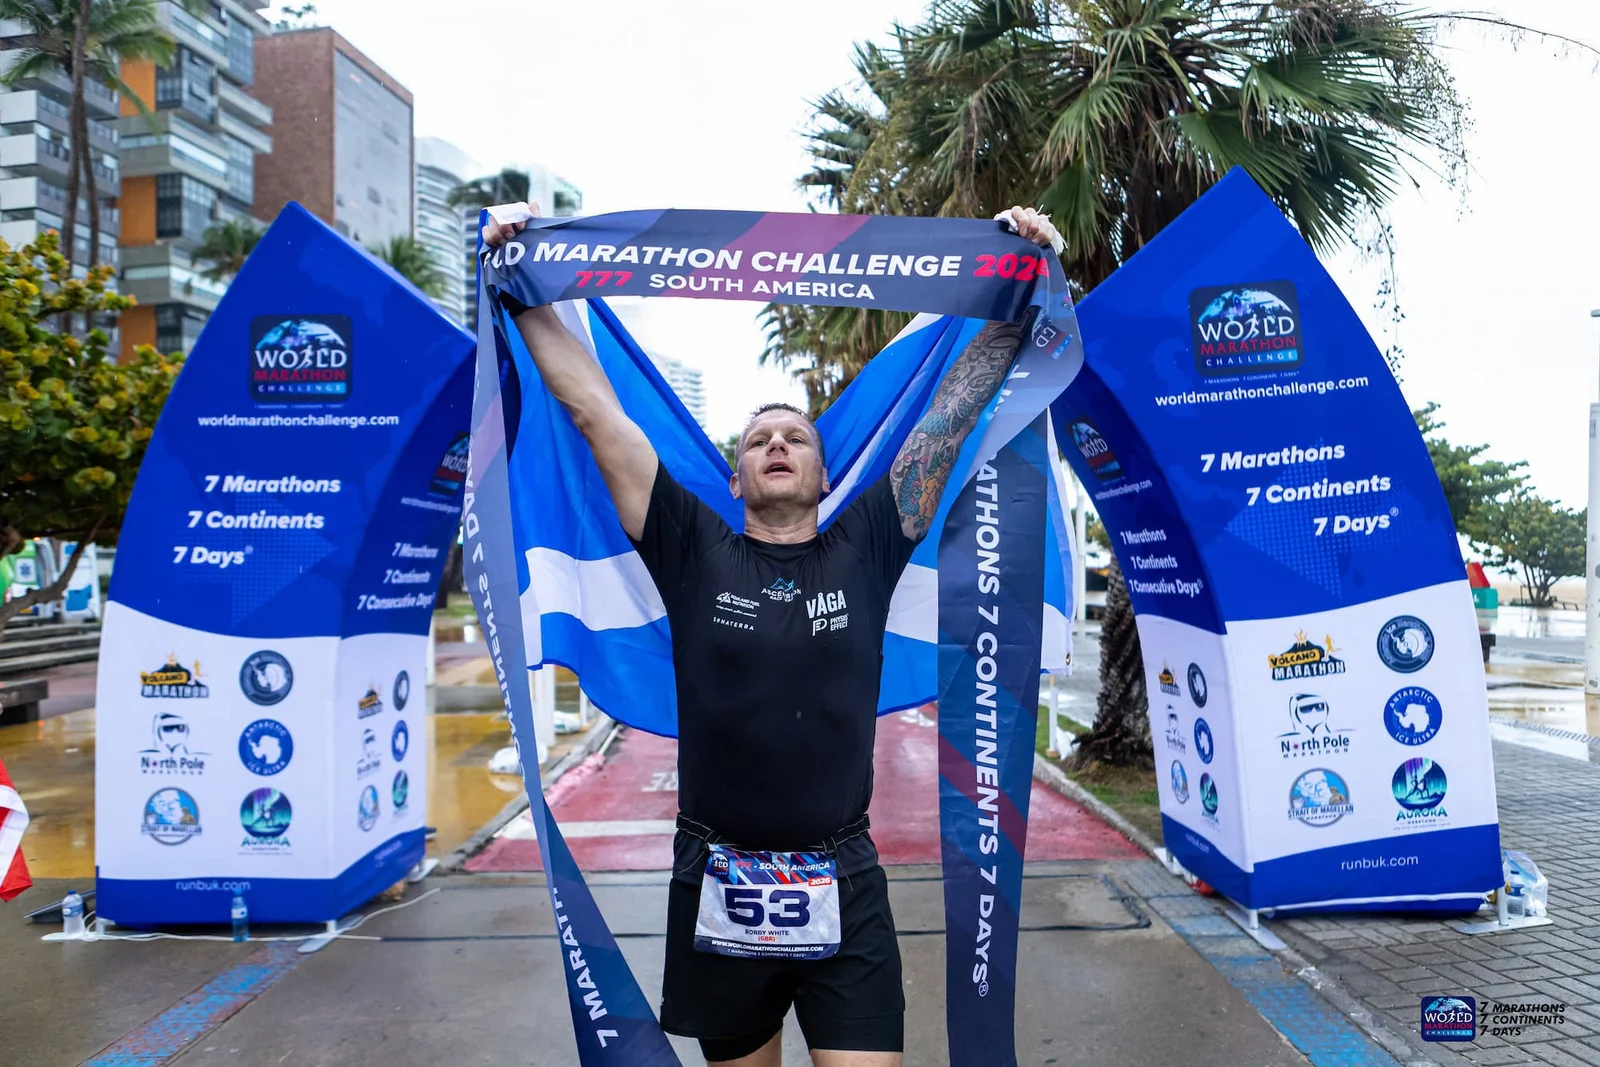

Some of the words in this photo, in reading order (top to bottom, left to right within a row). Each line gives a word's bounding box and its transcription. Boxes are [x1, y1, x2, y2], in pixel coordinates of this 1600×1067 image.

[533, 241, 742, 270] MARATHON
[752, 250, 961, 277] CHALLENGE
[575, 271, 633, 288] 777
[649, 273, 743, 293] SOUTH
[752, 277, 875, 300] AMERICA
[1200, 335, 1297, 357] MARATHON
[1205, 351, 1294, 367] CHALLENGE
[254, 369, 346, 381] MARATHON
[258, 383, 343, 393] CHALLENGE
[1155, 374, 1369, 407] worldmarathonchallenge.com
[198, 413, 400, 429] worldmarathonchallenge.com
[1200, 453, 1216, 473] 7
[1220, 443, 1345, 472] Marathons
[204, 475, 220, 493] 7
[221, 474, 341, 494] Marathons
[1246, 486, 1262, 506] 7
[1265, 474, 1391, 505] Continents
[187, 510, 204, 529] 7
[205, 510, 325, 529] Continents
[1313, 517, 1329, 536] 7
[1127, 528, 1167, 545] Marathons
[173, 545, 186, 564] 7
[1136, 554, 1178, 569] Continents
[1134, 578, 1176, 594] Consecutive
[805, 589, 847, 619] VÅGA
[977, 606, 999, 626] 7
[1269, 652, 1317, 667] VOLCANO
[1273, 660, 1346, 681] MARATHON
[141, 684, 209, 698] MARATHON
[1388, 688, 1434, 708] ANTARCTIC
[975, 631, 999, 855] CONTINENTS
[1323, 735, 1350, 748] Pole
[1395, 731, 1411, 745] ICE
[1412, 727, 1436, 745] ULTRA
[180, 755, 205, 770] Pole
[1287, 807, 1310, 819] STRAIT
[1311, 808, 1318, 816] OF
[1395, 806, 1448, 821] AURORA
[759, 862, 790, 871] SOUTH
[791, 862, 830, 872] AMERICA
[1340, 855, 1419, 871] runbuk.com
[810, 877, 831, 886] 2026
[979, 865, 997, 885] 7
[175, 880, 251, 892] runbuk.com
[724, 887, 811, 928] 53
[744, 928, 766, 936] BOBBY
[711, 940, 824, 952] WWW.WORLDMARATHONCHALLENGE.COM
[596, 1029, 619, 1048] 7
